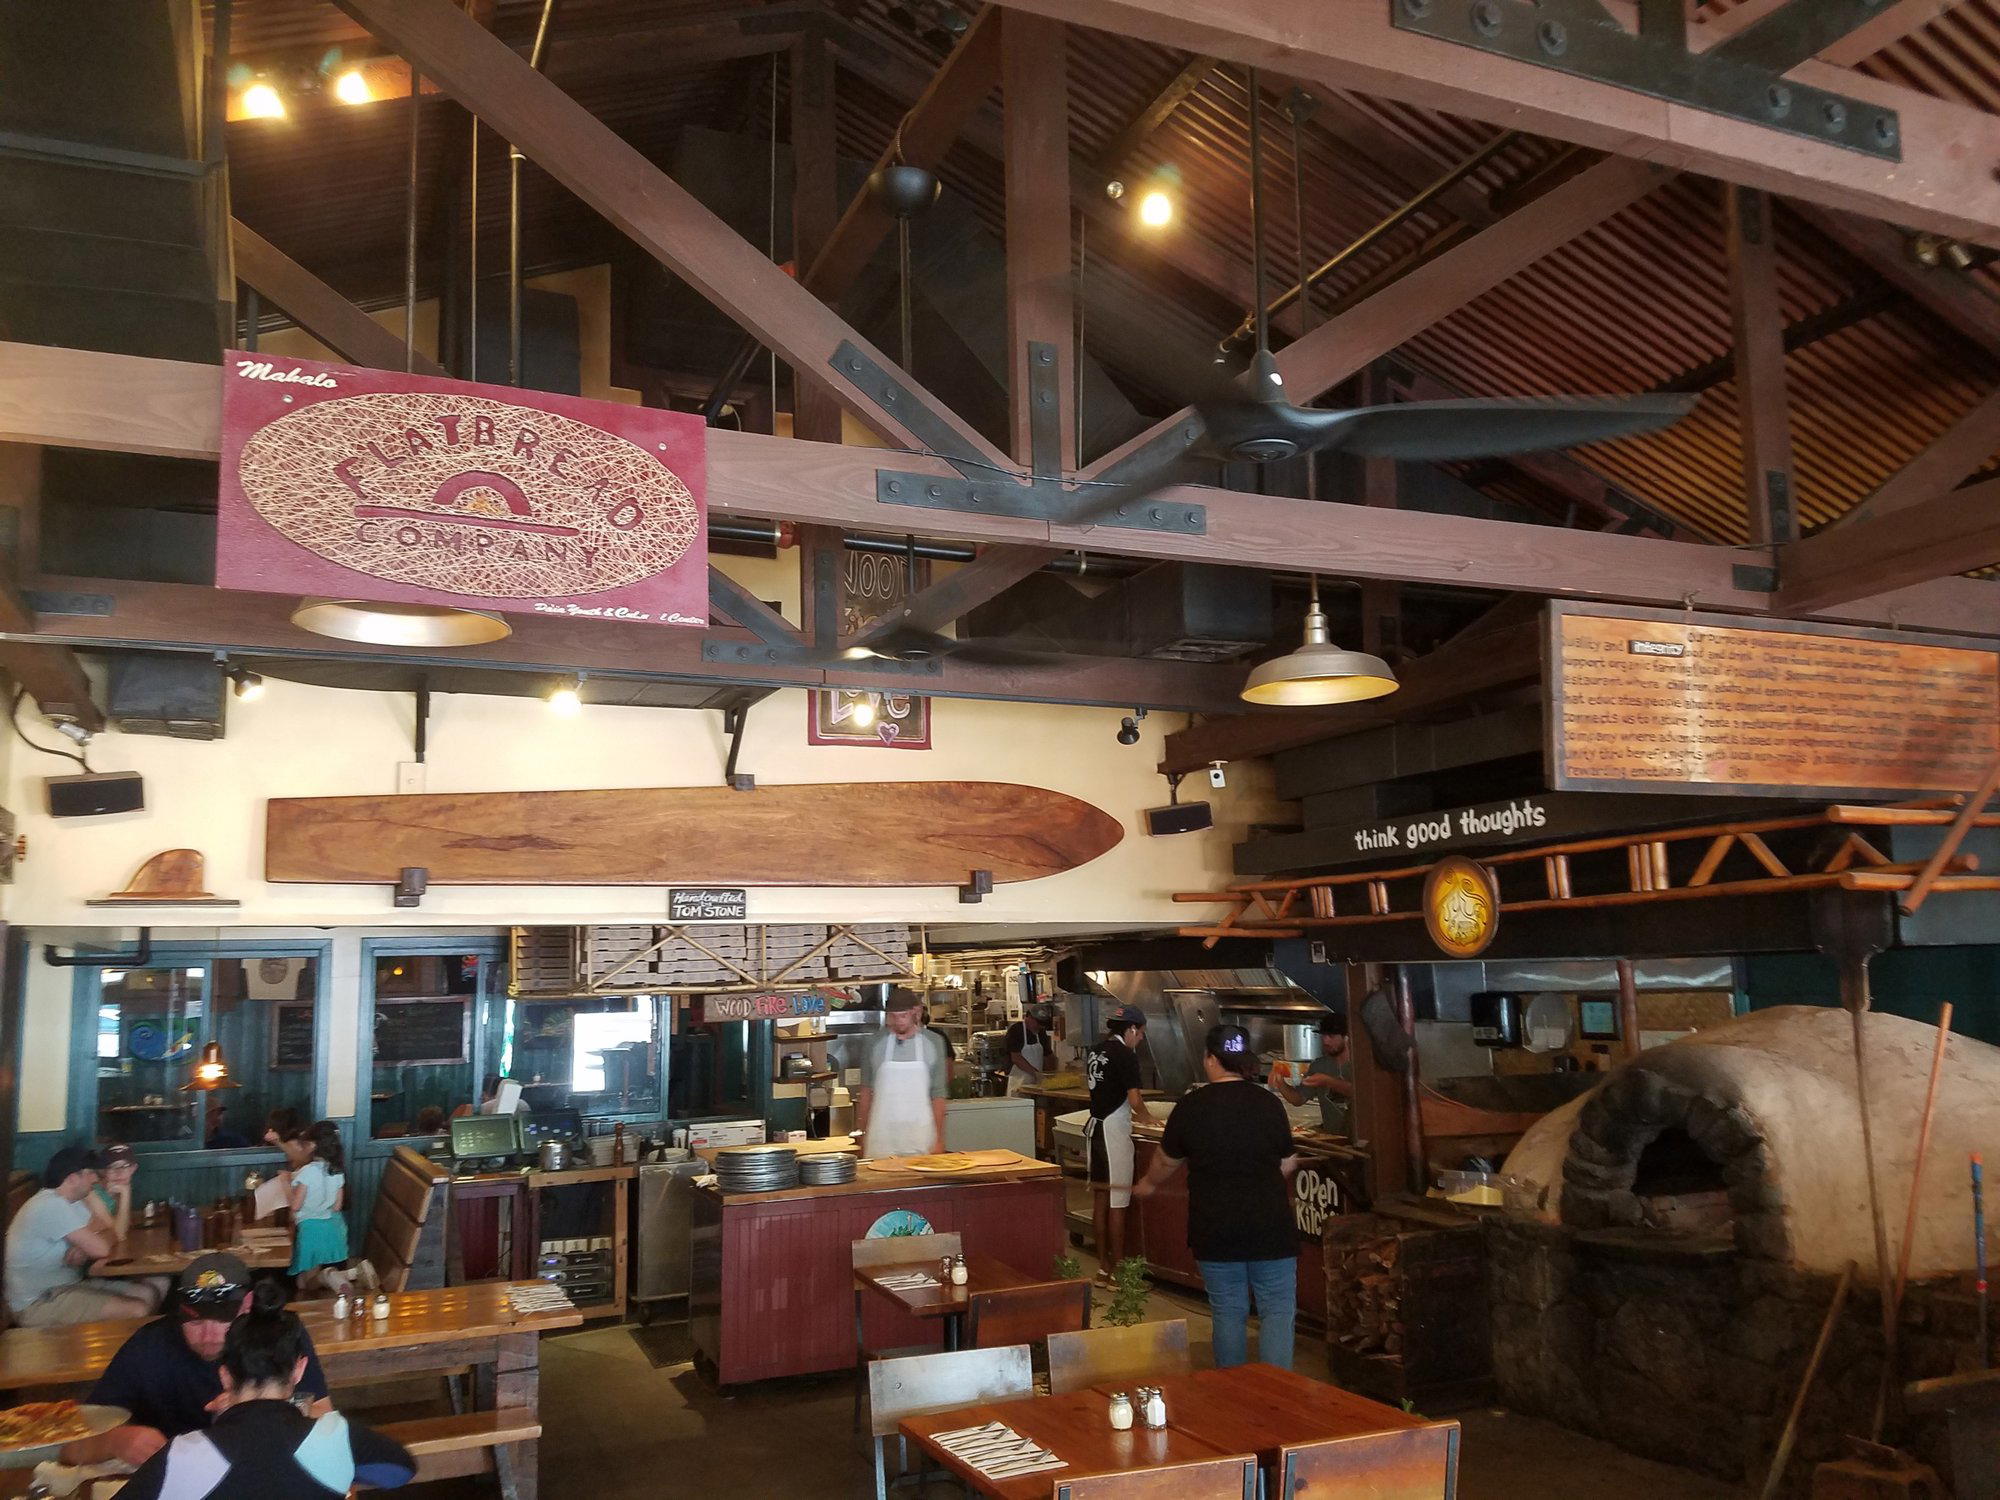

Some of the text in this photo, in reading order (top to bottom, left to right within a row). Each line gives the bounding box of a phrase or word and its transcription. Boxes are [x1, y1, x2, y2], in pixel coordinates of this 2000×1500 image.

[236, 361, 338, 389] Mahalo
[356, 521, 598, 569] COMPANY
[603, 607, 615, 617] &
[1355, 799, 1547, 851] think good thoughts
[672, 904, 745, 918] TOM STONE
[714, 996, 752, 1017] WOOD
